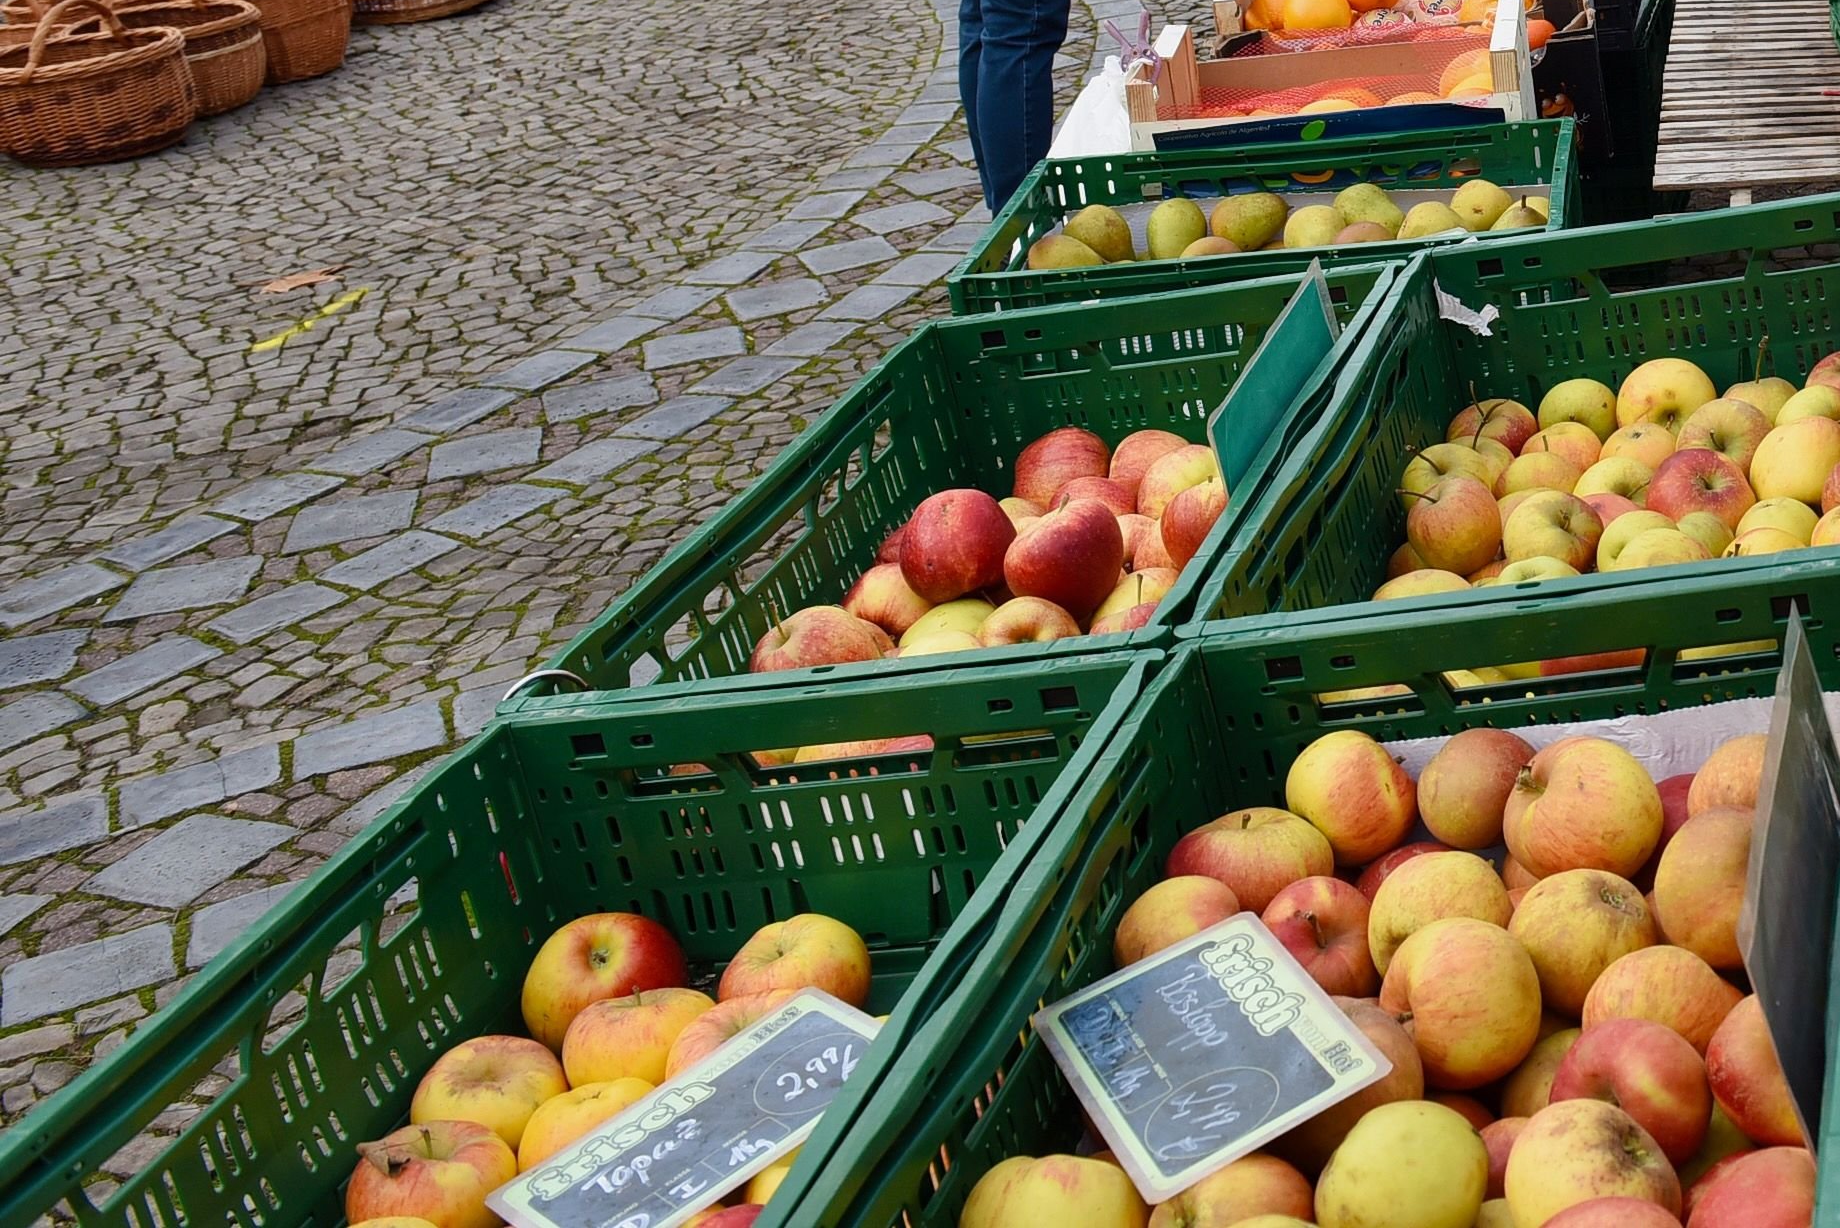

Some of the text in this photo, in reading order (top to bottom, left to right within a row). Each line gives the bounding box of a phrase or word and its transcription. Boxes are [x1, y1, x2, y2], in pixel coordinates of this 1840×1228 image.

[1199, 933, 1305, 1037] frisch
[1323, 1039, 1363, 1076] Hof
[526, 1081, 716, 1202] frisch
[750, 1005, 801, 1045] Hof
